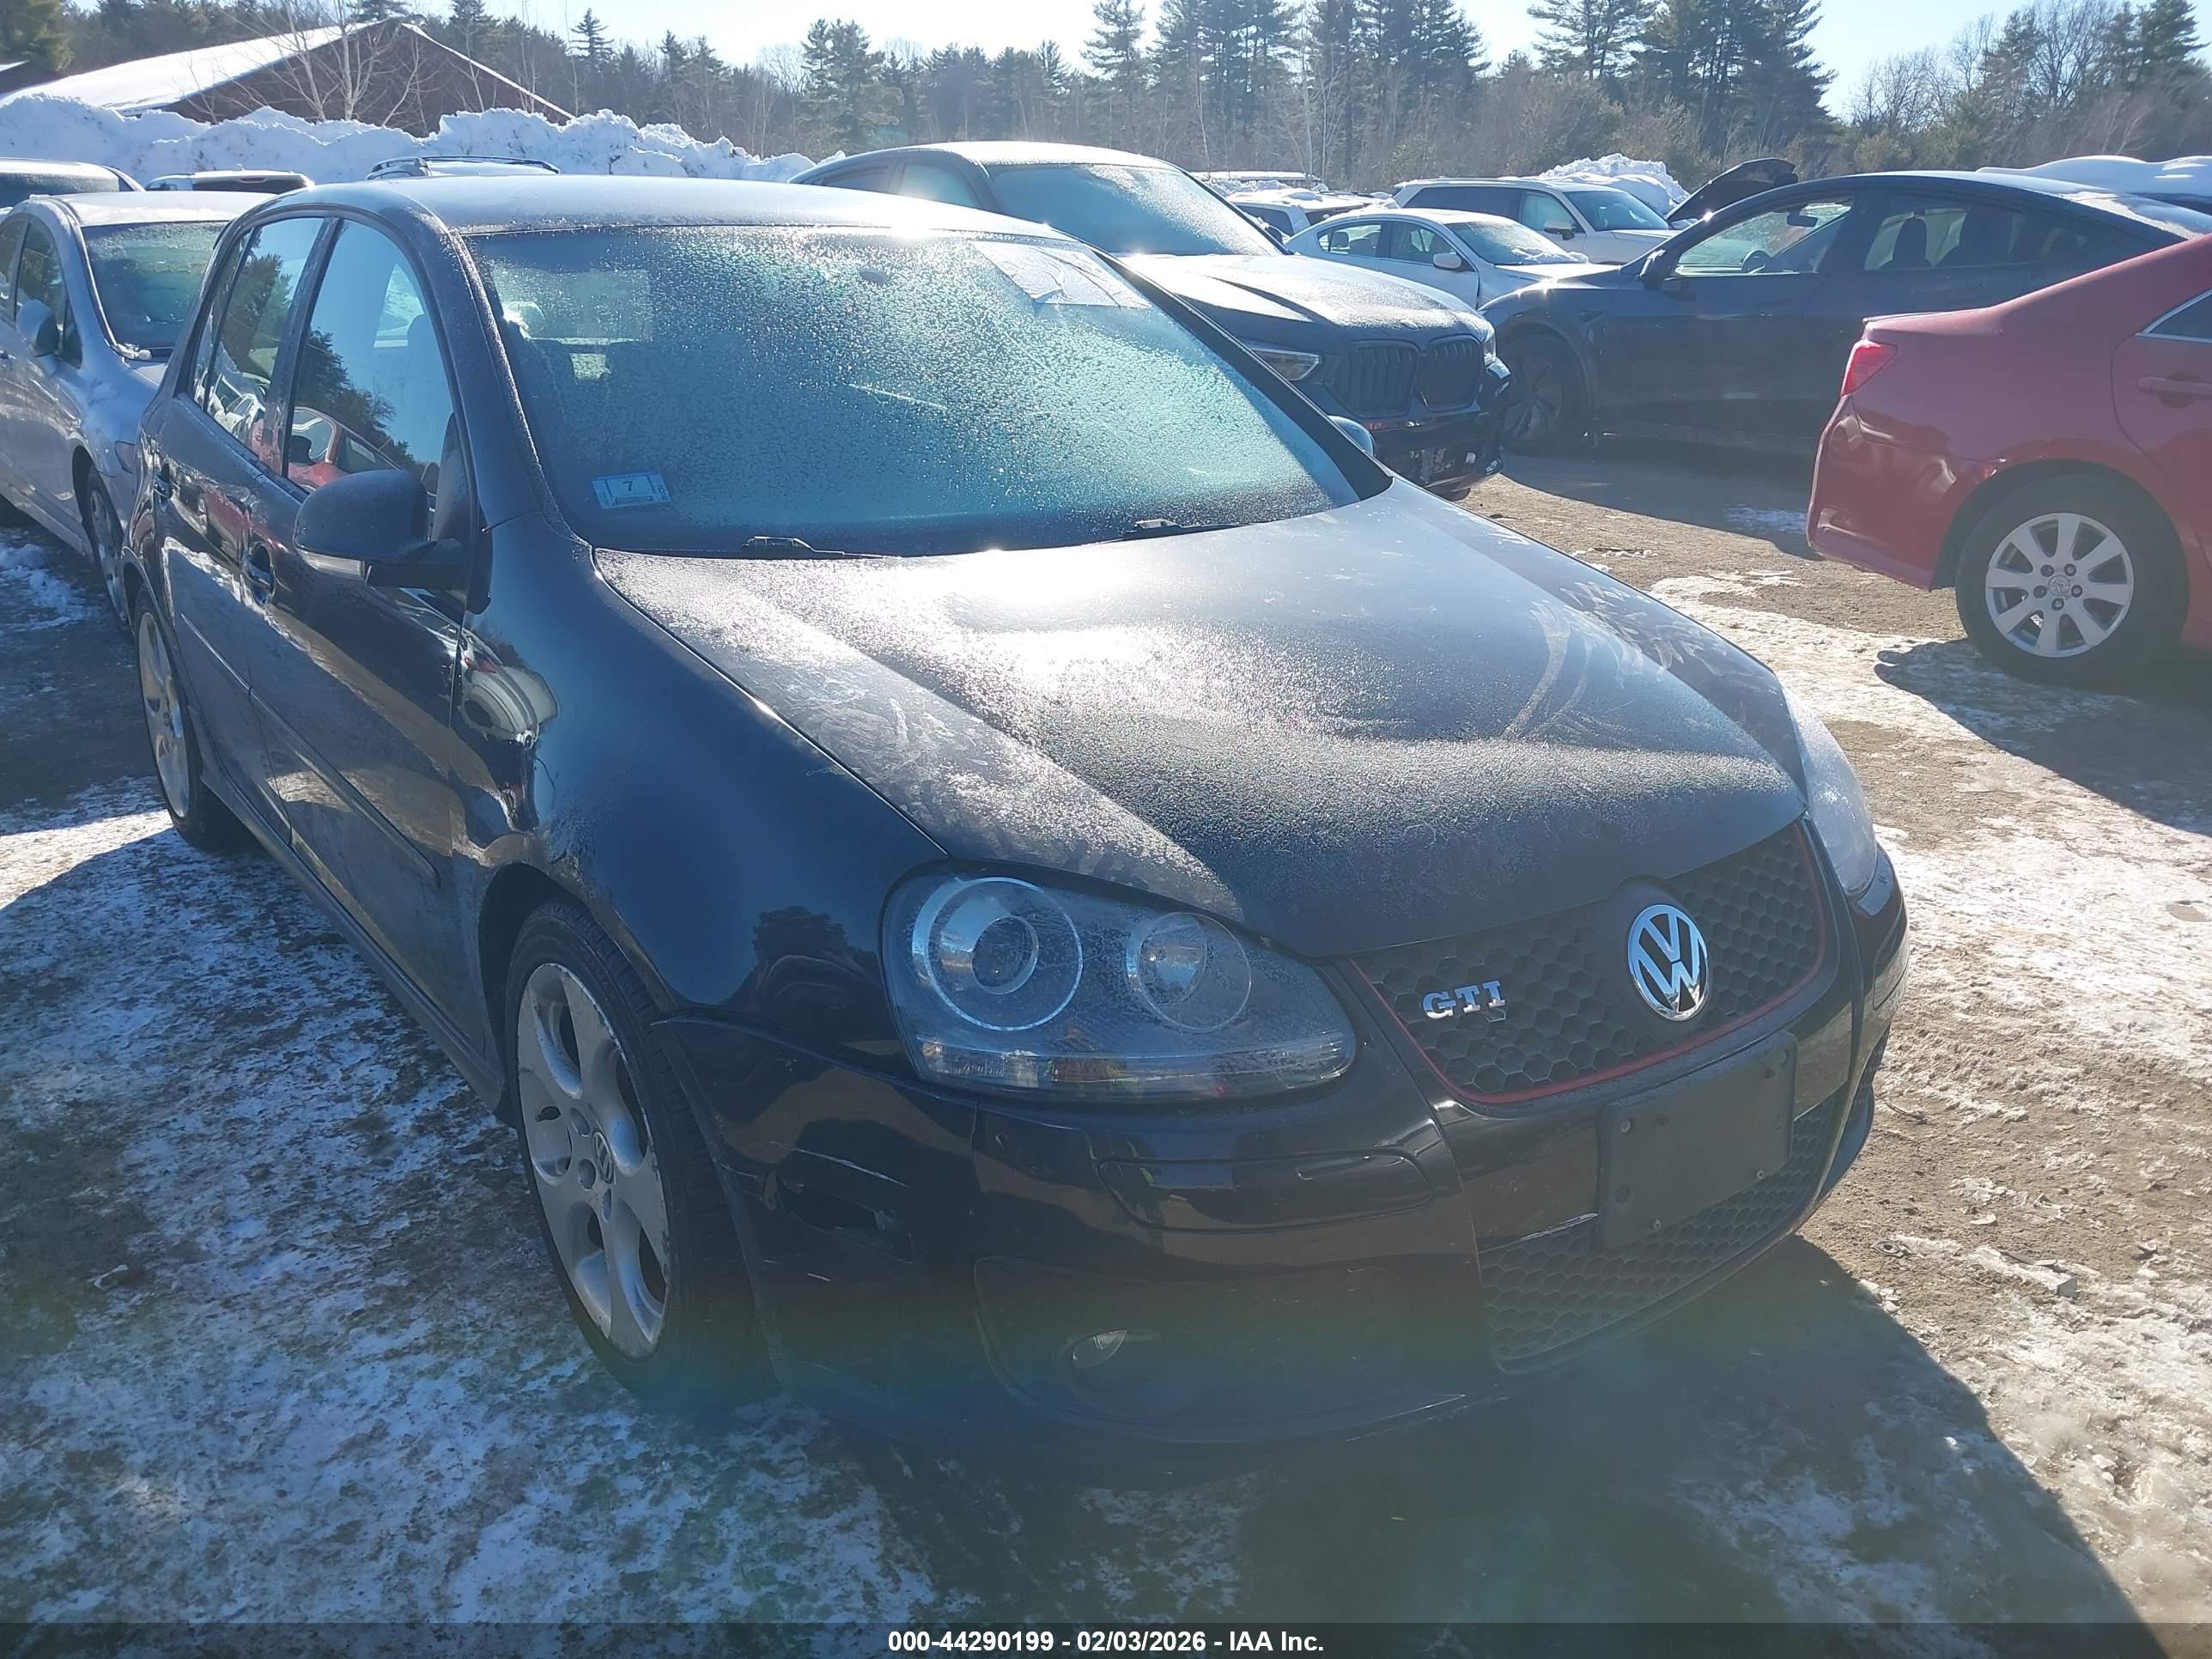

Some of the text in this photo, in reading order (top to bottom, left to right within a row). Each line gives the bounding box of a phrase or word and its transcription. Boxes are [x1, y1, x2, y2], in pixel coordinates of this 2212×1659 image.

[622, 481, 634, 492] 7
[1628, 904, 1710, 1022] VW
[1423, 981, 1506, 1019] GTI
